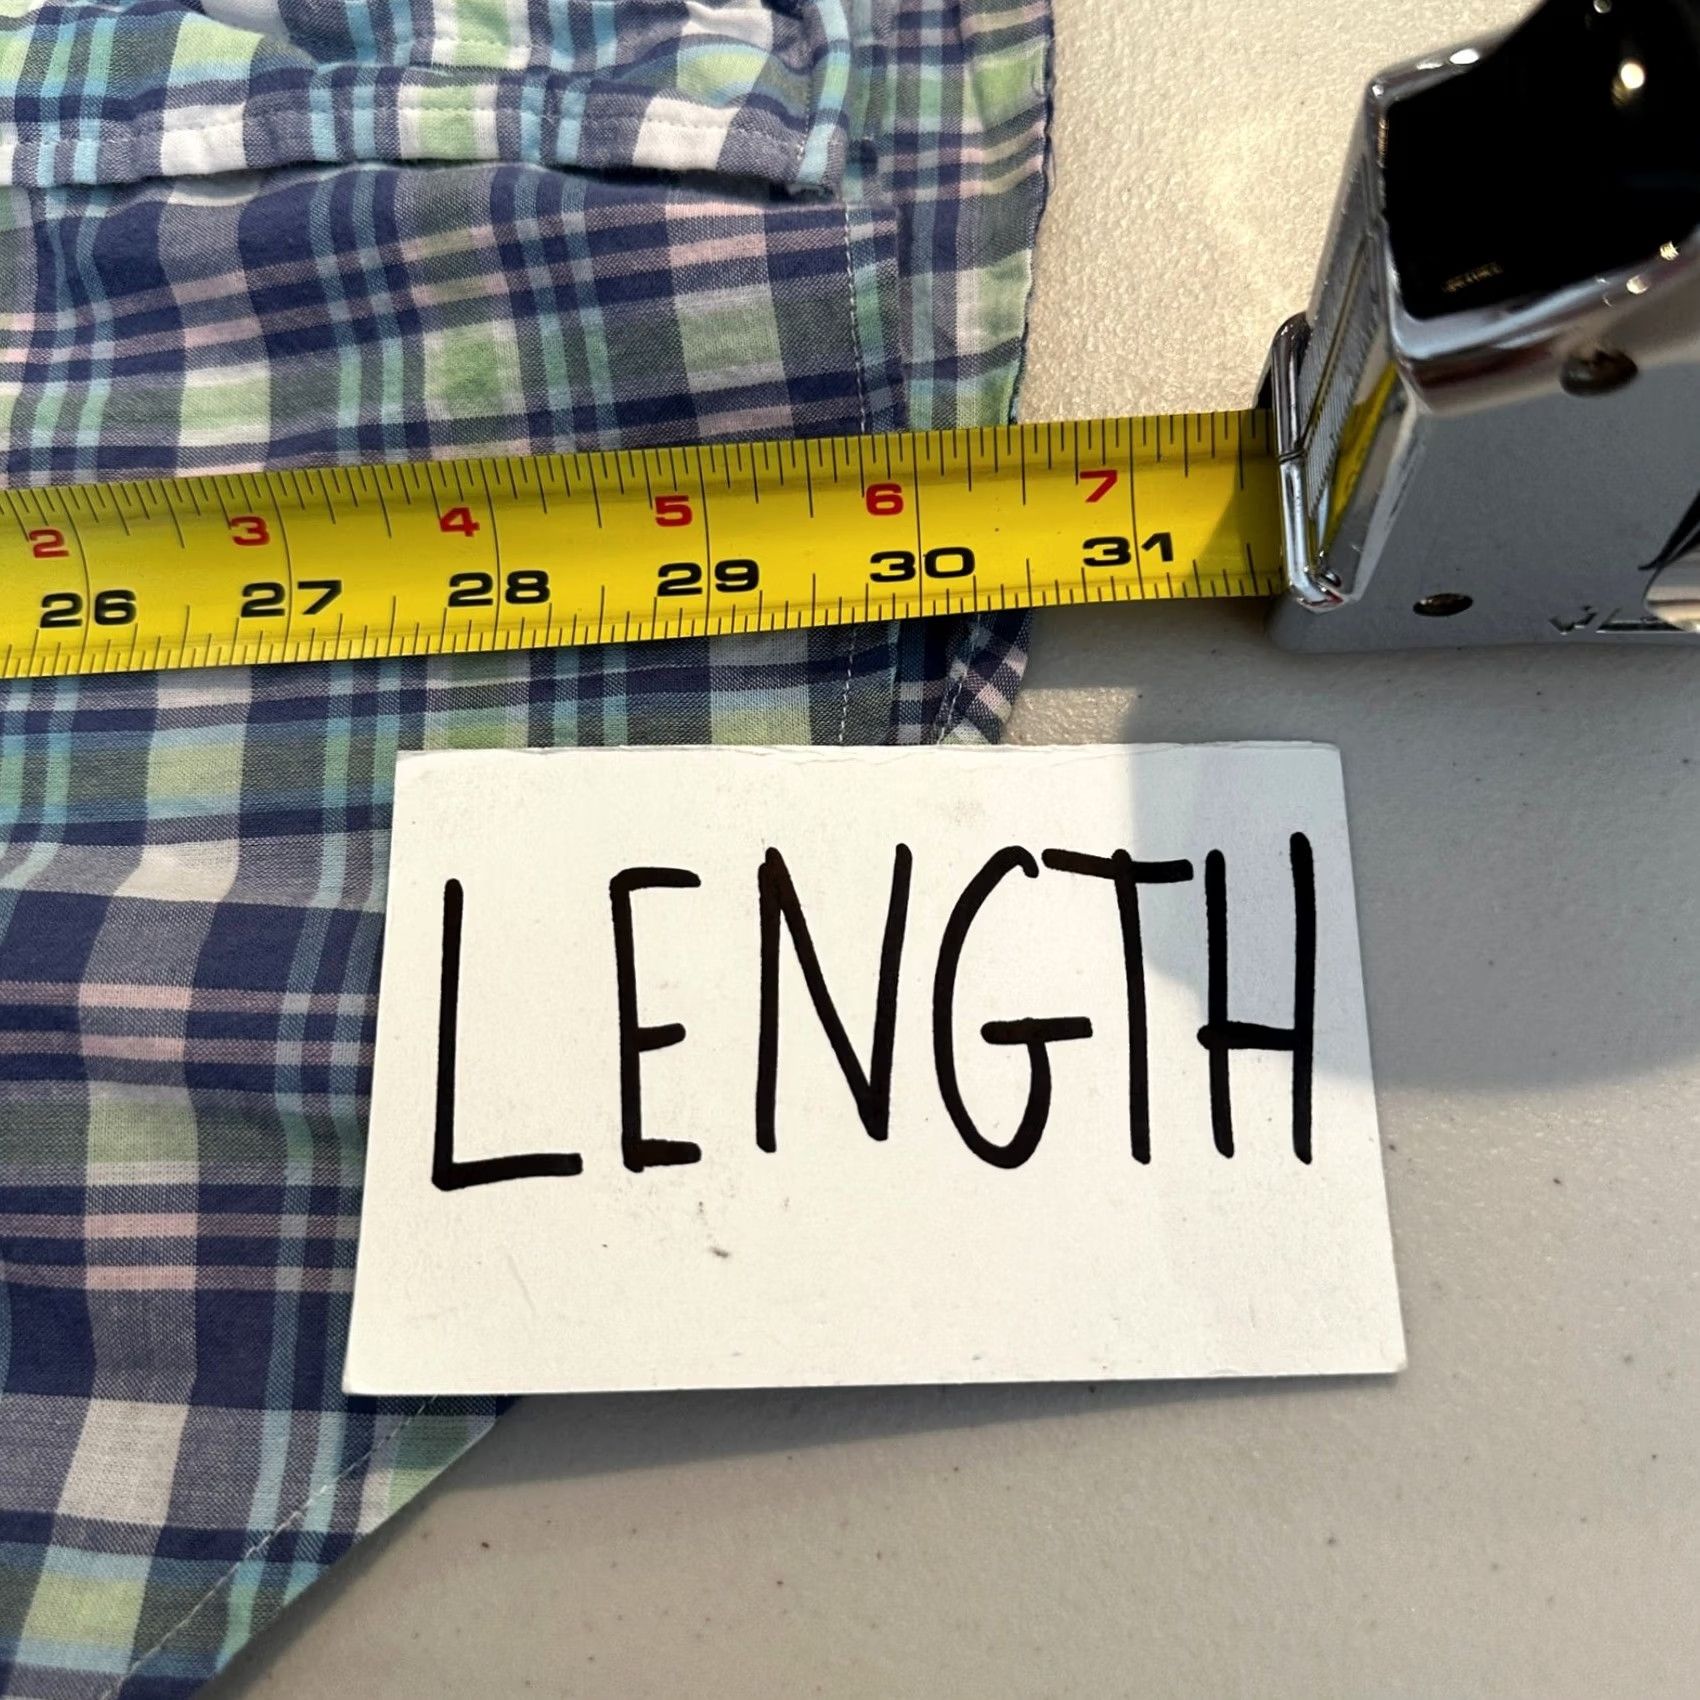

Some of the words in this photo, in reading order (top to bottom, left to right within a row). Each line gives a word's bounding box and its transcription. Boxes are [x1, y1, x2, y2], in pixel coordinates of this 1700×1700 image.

[28, 529, 69, 559] 2
[230, 516, 270, 547] 3
[439, 507, 480, 538] 4
[655, 494, 693, 528] 5
[865, 483, 904, 516] 6
[1078, 470, 1117, 503] 7
[39, 589, 136, 629] 26
[240, 579, 343, 618] 27
[448, 570, 550, 608] 28
[657, 559, 760, 597] 29
[869, 547, 976, 583] 30
[1082, 532, 1175, 567] 31
[431, 831, 1318, 1191] LENGTH
